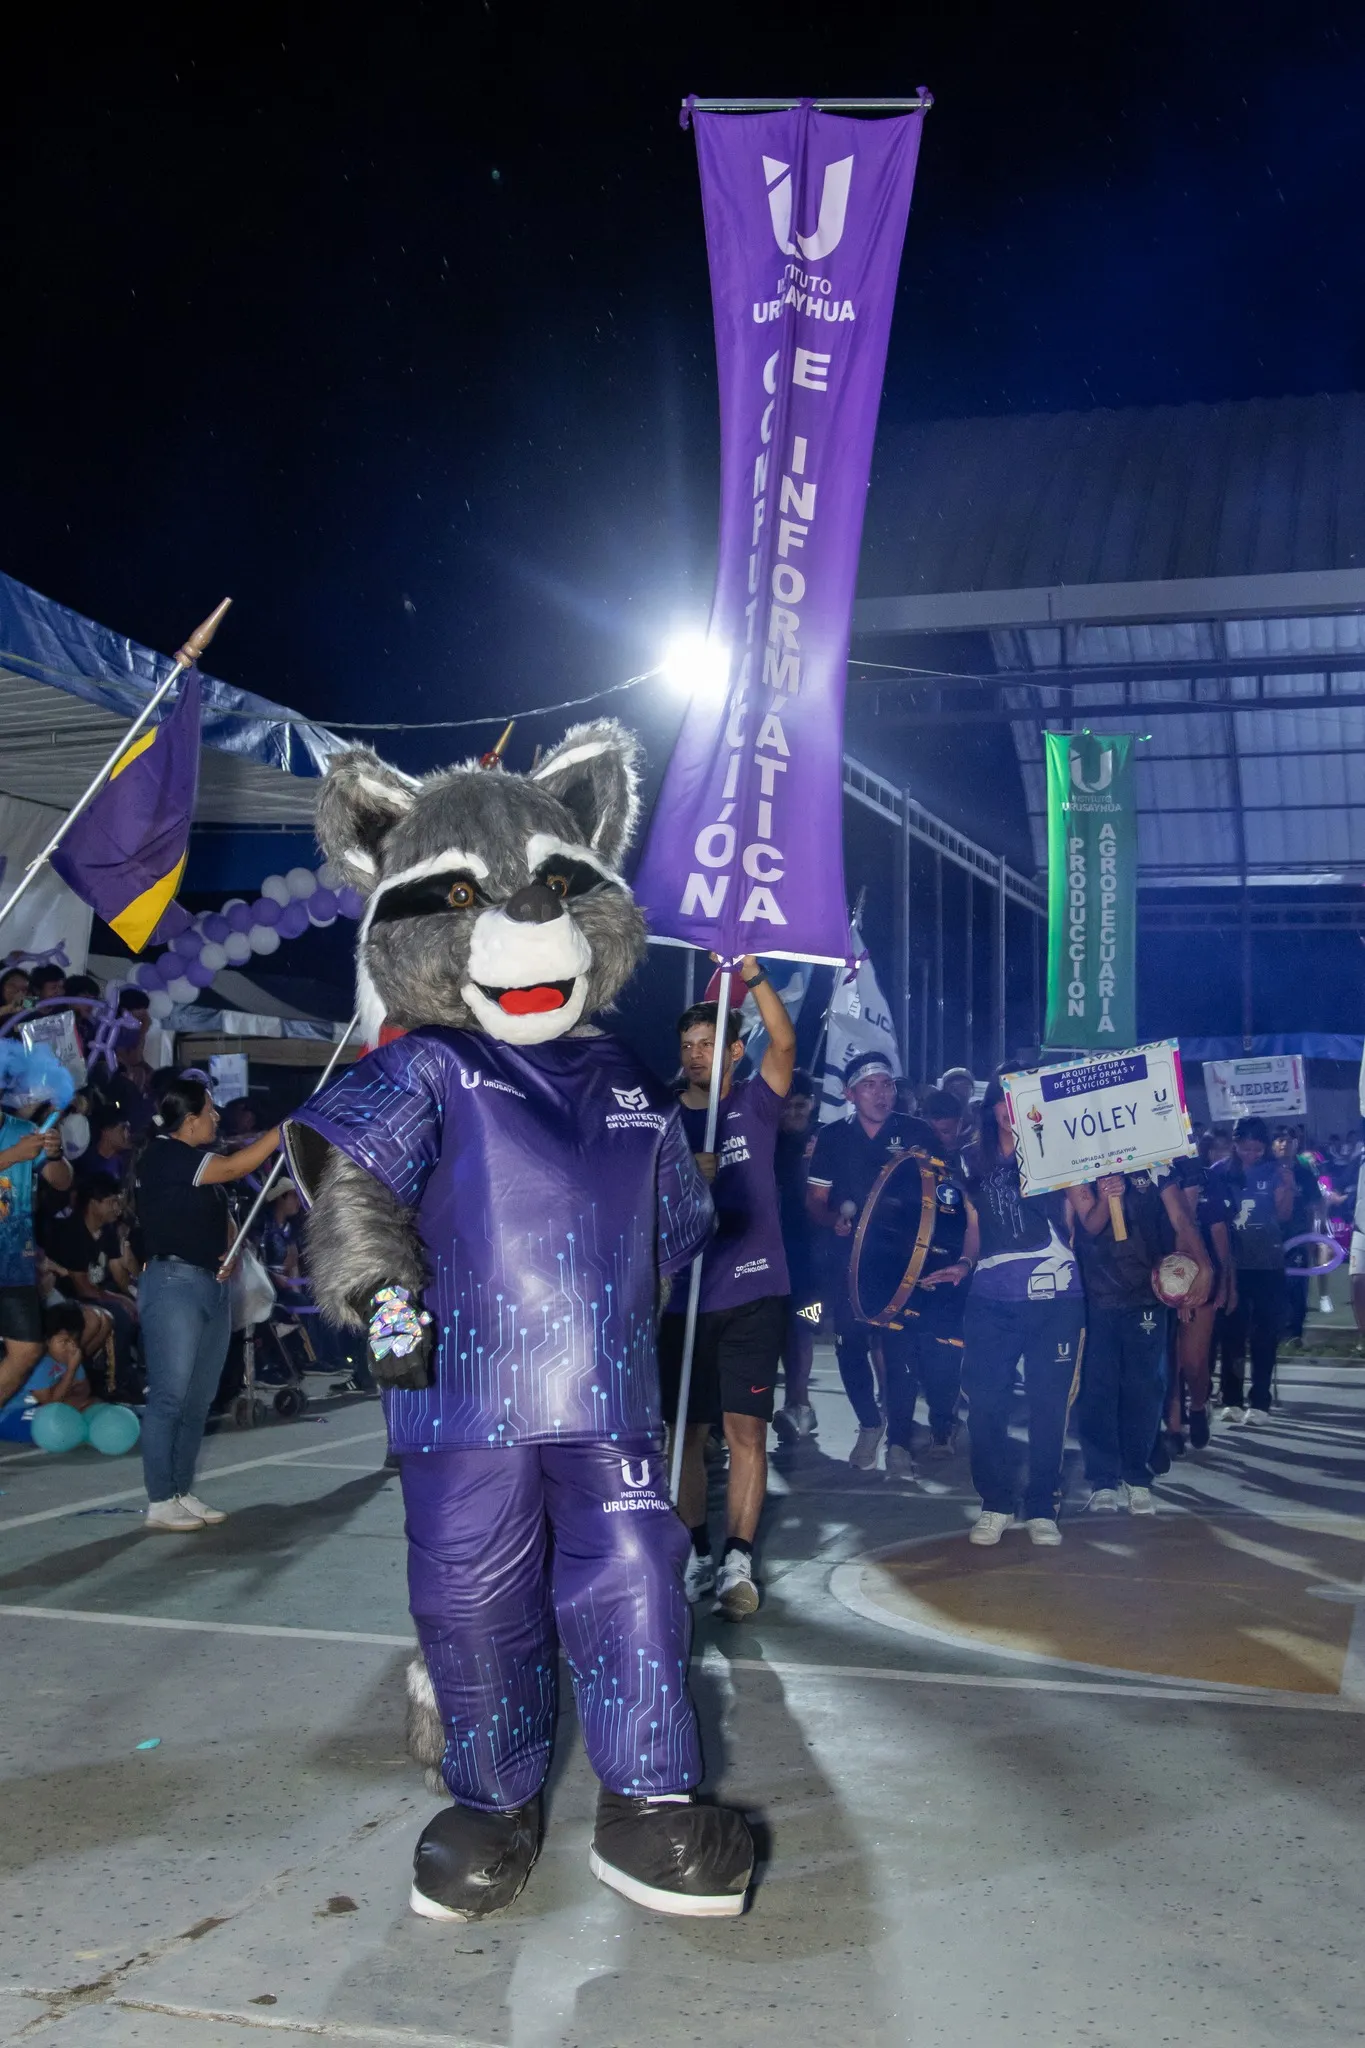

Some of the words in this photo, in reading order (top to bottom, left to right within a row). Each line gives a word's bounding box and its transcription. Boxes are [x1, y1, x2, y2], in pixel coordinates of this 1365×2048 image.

[792, 346, 831, 392] E
[739, 435, 818, 926] INFORMÁTICA
[1097, 823, 1117, 1033] AGROPECUARIA
[1054, 1081, 1065, 1090] DE
[1066, 1066, 1129, 1086] PLATAFORMAS
[1061, 1060, 1126, 1080] ARQUITECTURA
[1066, 1078, 1110, 1094] SERVICIOS
[1229, 1080, 1289, 1097] AJEDREZ
[607, 1121, 619, 1129] EN
[1063, 1102, 1138, 1140] VÓLEY
[1071, 1153, 1105, 1166] OLIMPIADAS
[620, 1490, 656, 1498] INSTITUTO
[603, 1499, 669, 1513] URUSAYHUA
